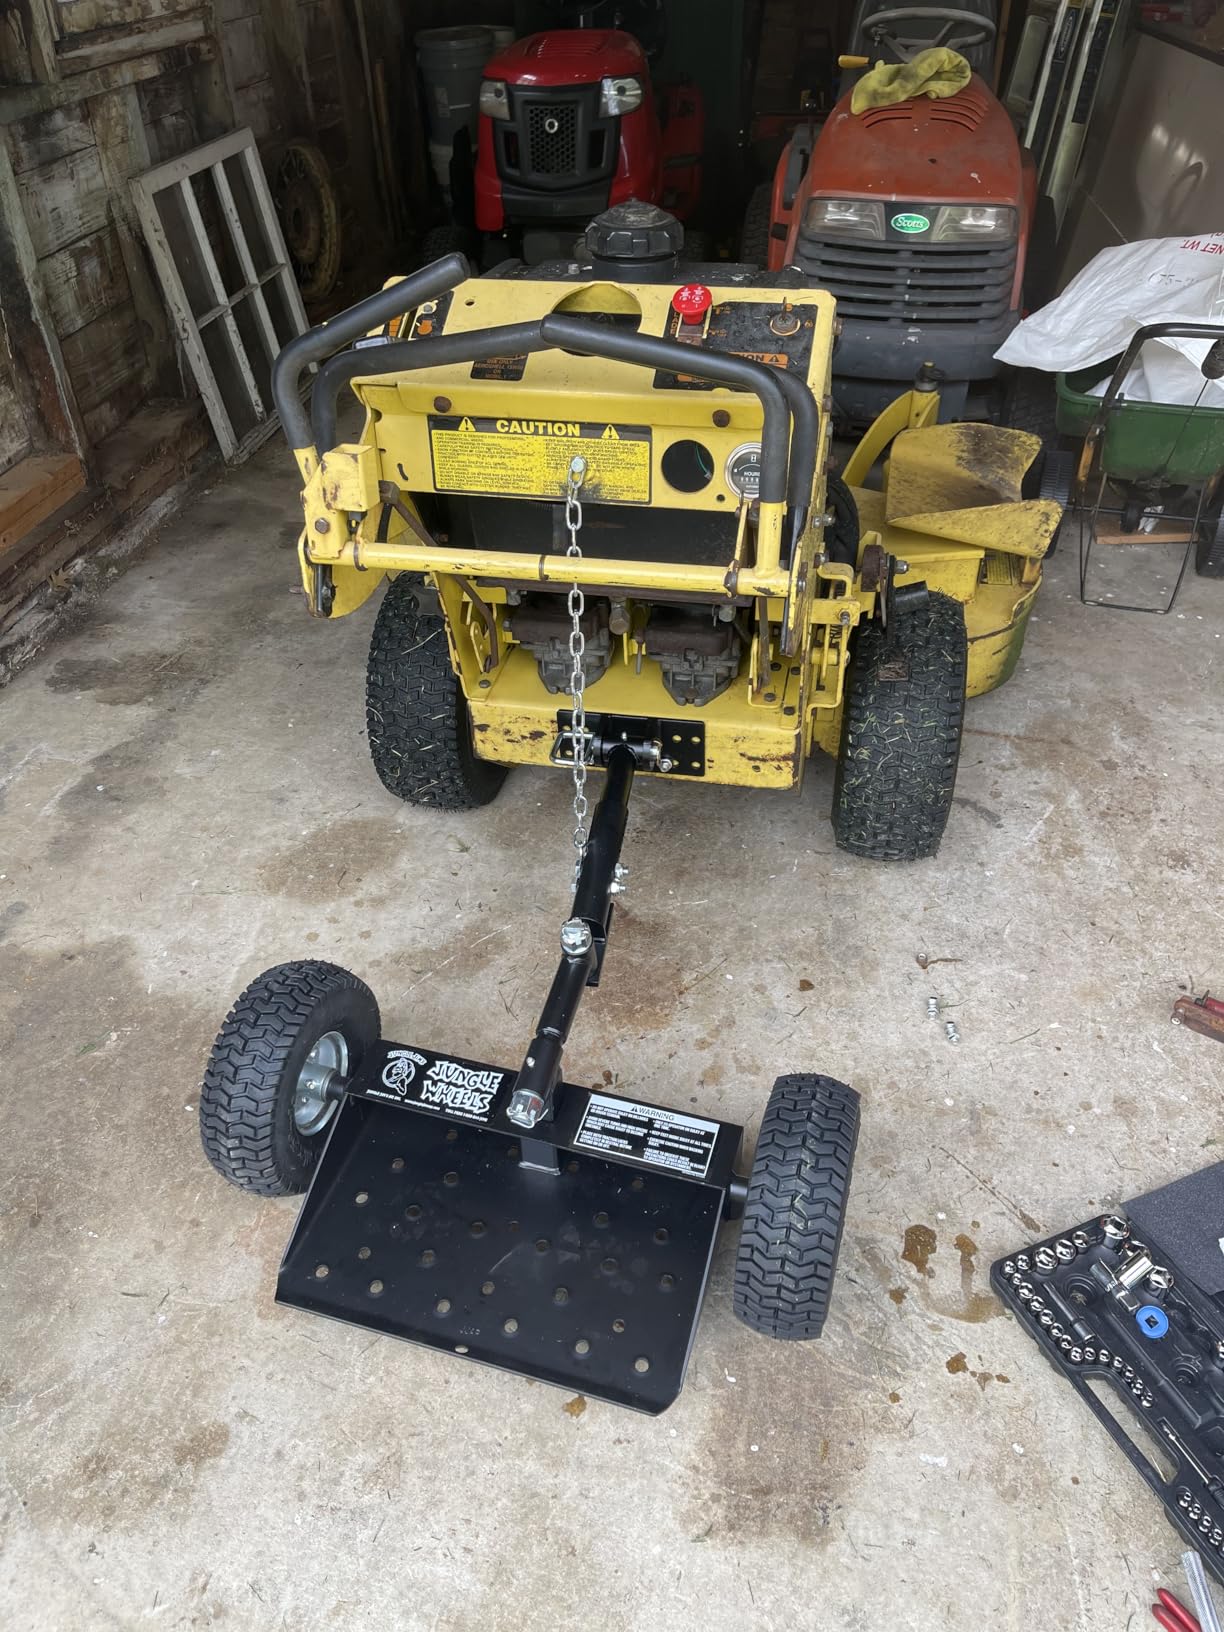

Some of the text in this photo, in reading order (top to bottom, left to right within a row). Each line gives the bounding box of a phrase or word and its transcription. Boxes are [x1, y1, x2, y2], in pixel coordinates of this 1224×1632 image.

[896, 216, 924, 228] Scotts
[1200, 243, 1224, 255] NET
[670, 312, 679, 336] LADE
[495, 420, 580, 436] CAUTION
[426, 1061, 504, 1094] JUNGLE
[420, 1080, 494, 1113] WHEELS
[638, 1107, 675, 1121] WARNING
